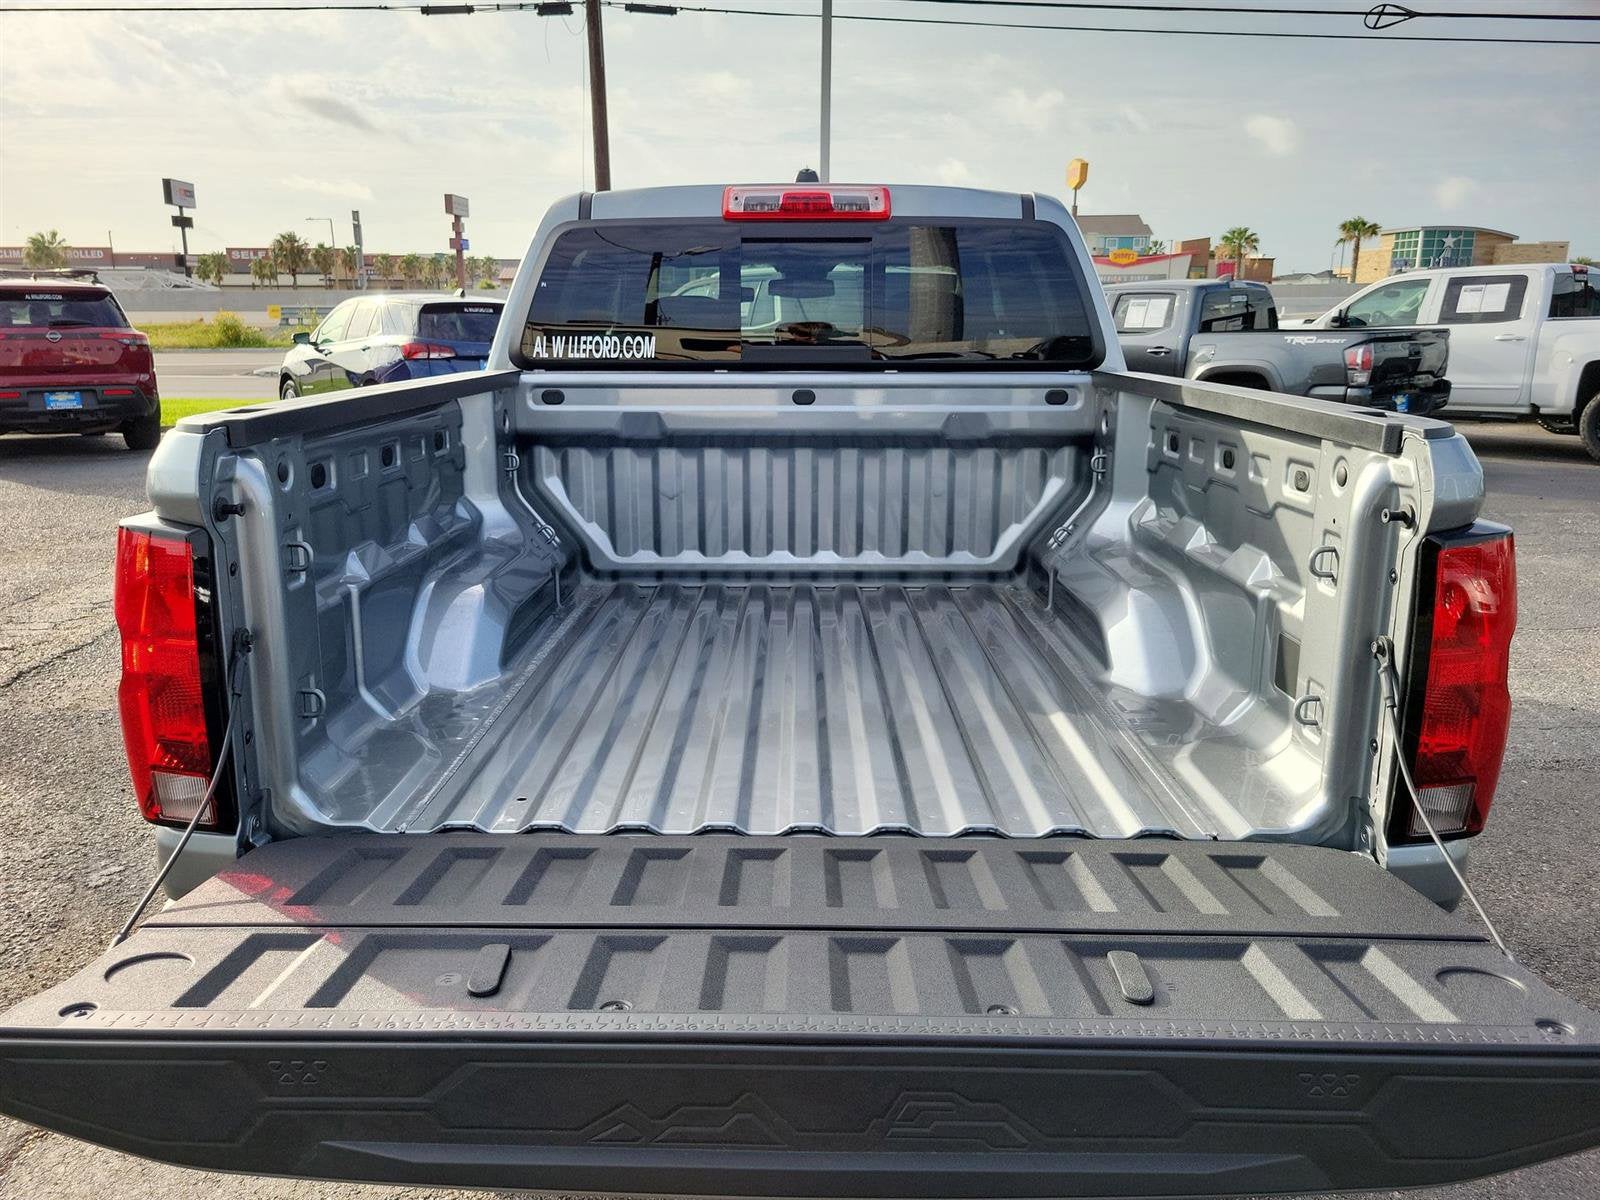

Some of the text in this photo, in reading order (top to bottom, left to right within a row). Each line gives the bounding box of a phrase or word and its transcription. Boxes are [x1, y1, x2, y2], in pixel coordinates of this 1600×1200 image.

[231, 249, 267, 260] SELF
[1284, 336, 1317, 345] TRD
[533, 336, 549, 358] AL
[1072, 1028, 1097, 1036] 33
[1134, 1029, 1158, 1037] 35
[1195, 1030, 1218, 1038] 37
[1256, 1031, 1281, 1039] 39
[1288, 1031, 1315, 1039] 40
